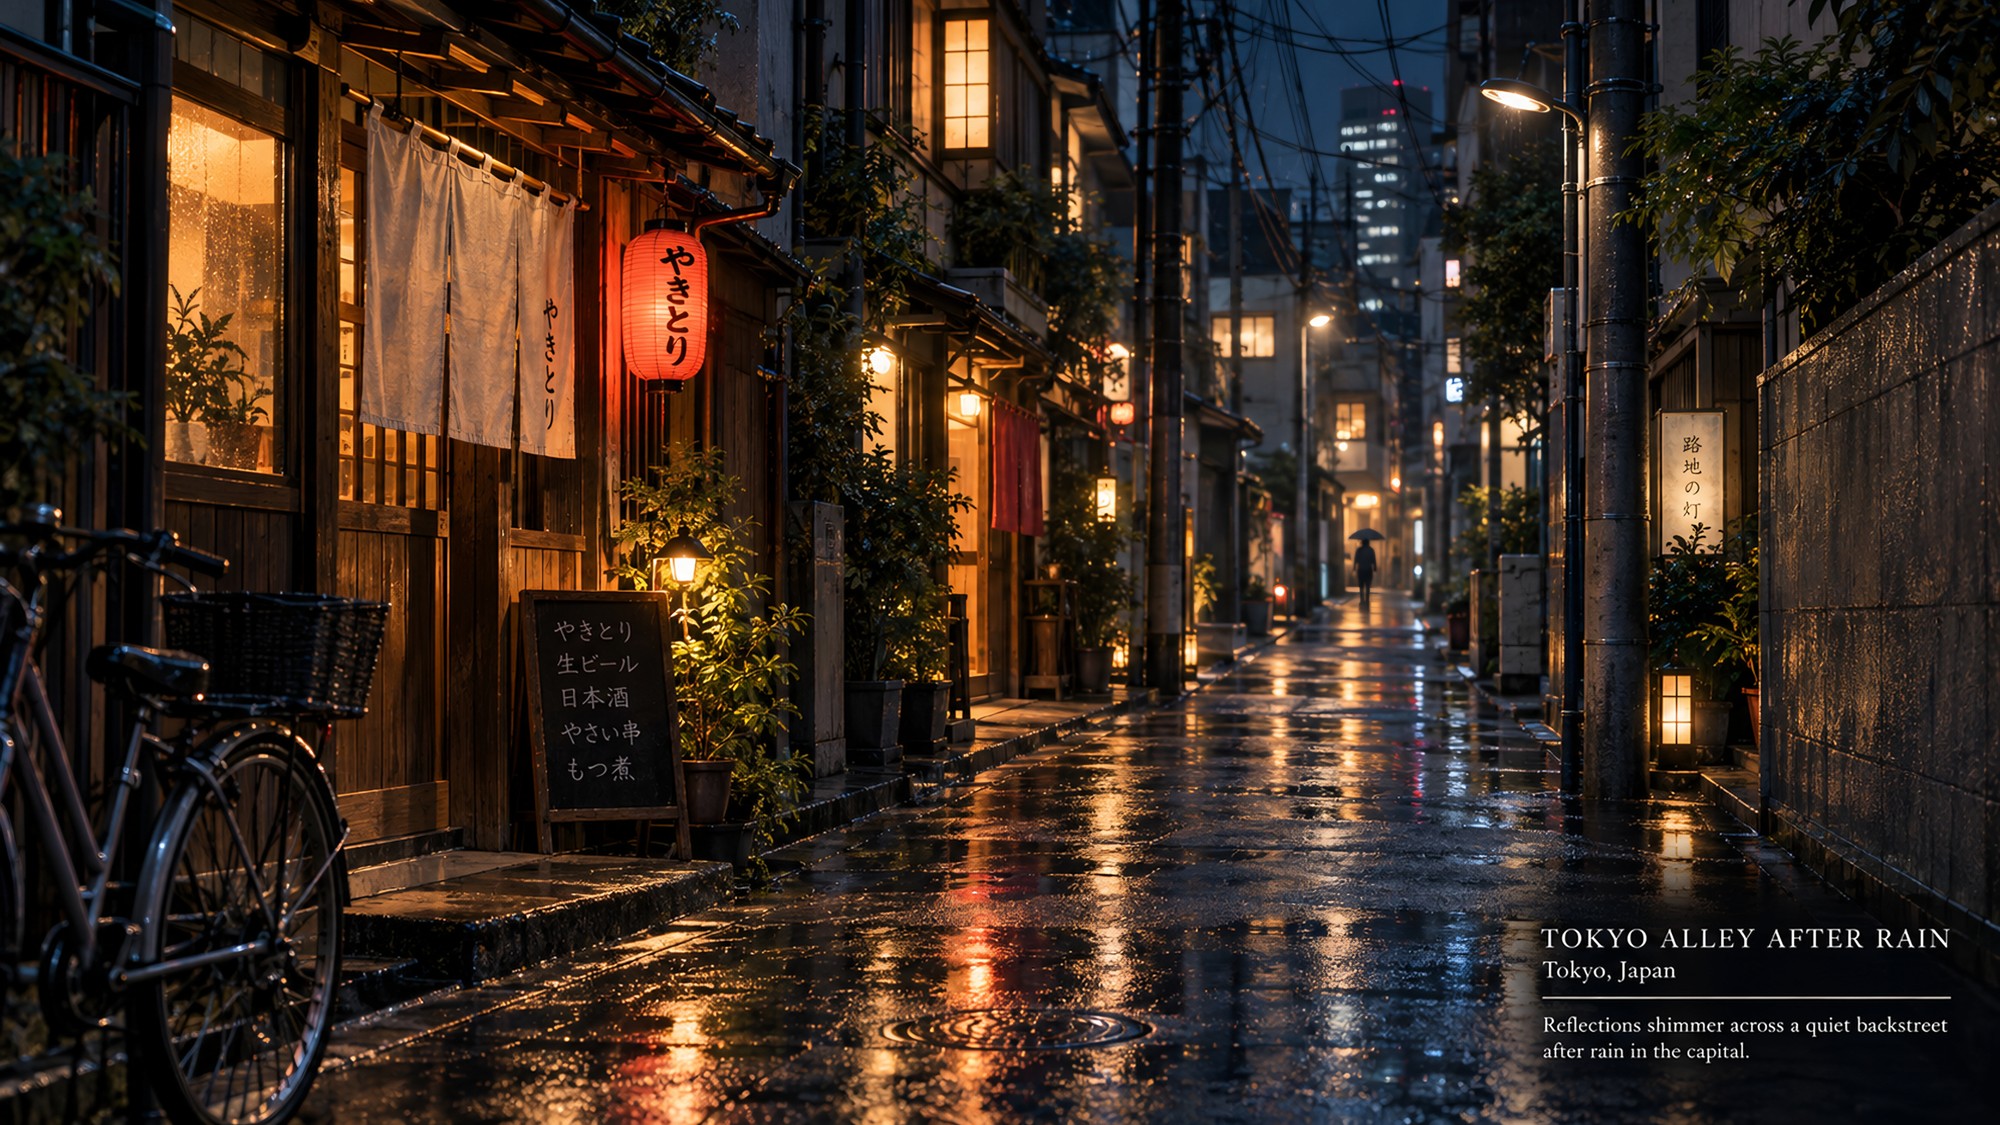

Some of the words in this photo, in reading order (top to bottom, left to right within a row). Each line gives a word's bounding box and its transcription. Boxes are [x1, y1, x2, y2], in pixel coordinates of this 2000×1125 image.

[660, 246, 695, 366] やきとり
[543, 298, 558, 430] やきとり
[1682, 435, 1703, 519] 路地の灯
[554, 619, 632, 643] やきとり
[557, 652, 639, 675] 生ビール
[561, 685, 630, 709] 日本酒
[561, 719, 641, 746] やさい串
[567, 755, 635, 781] もつ煮
